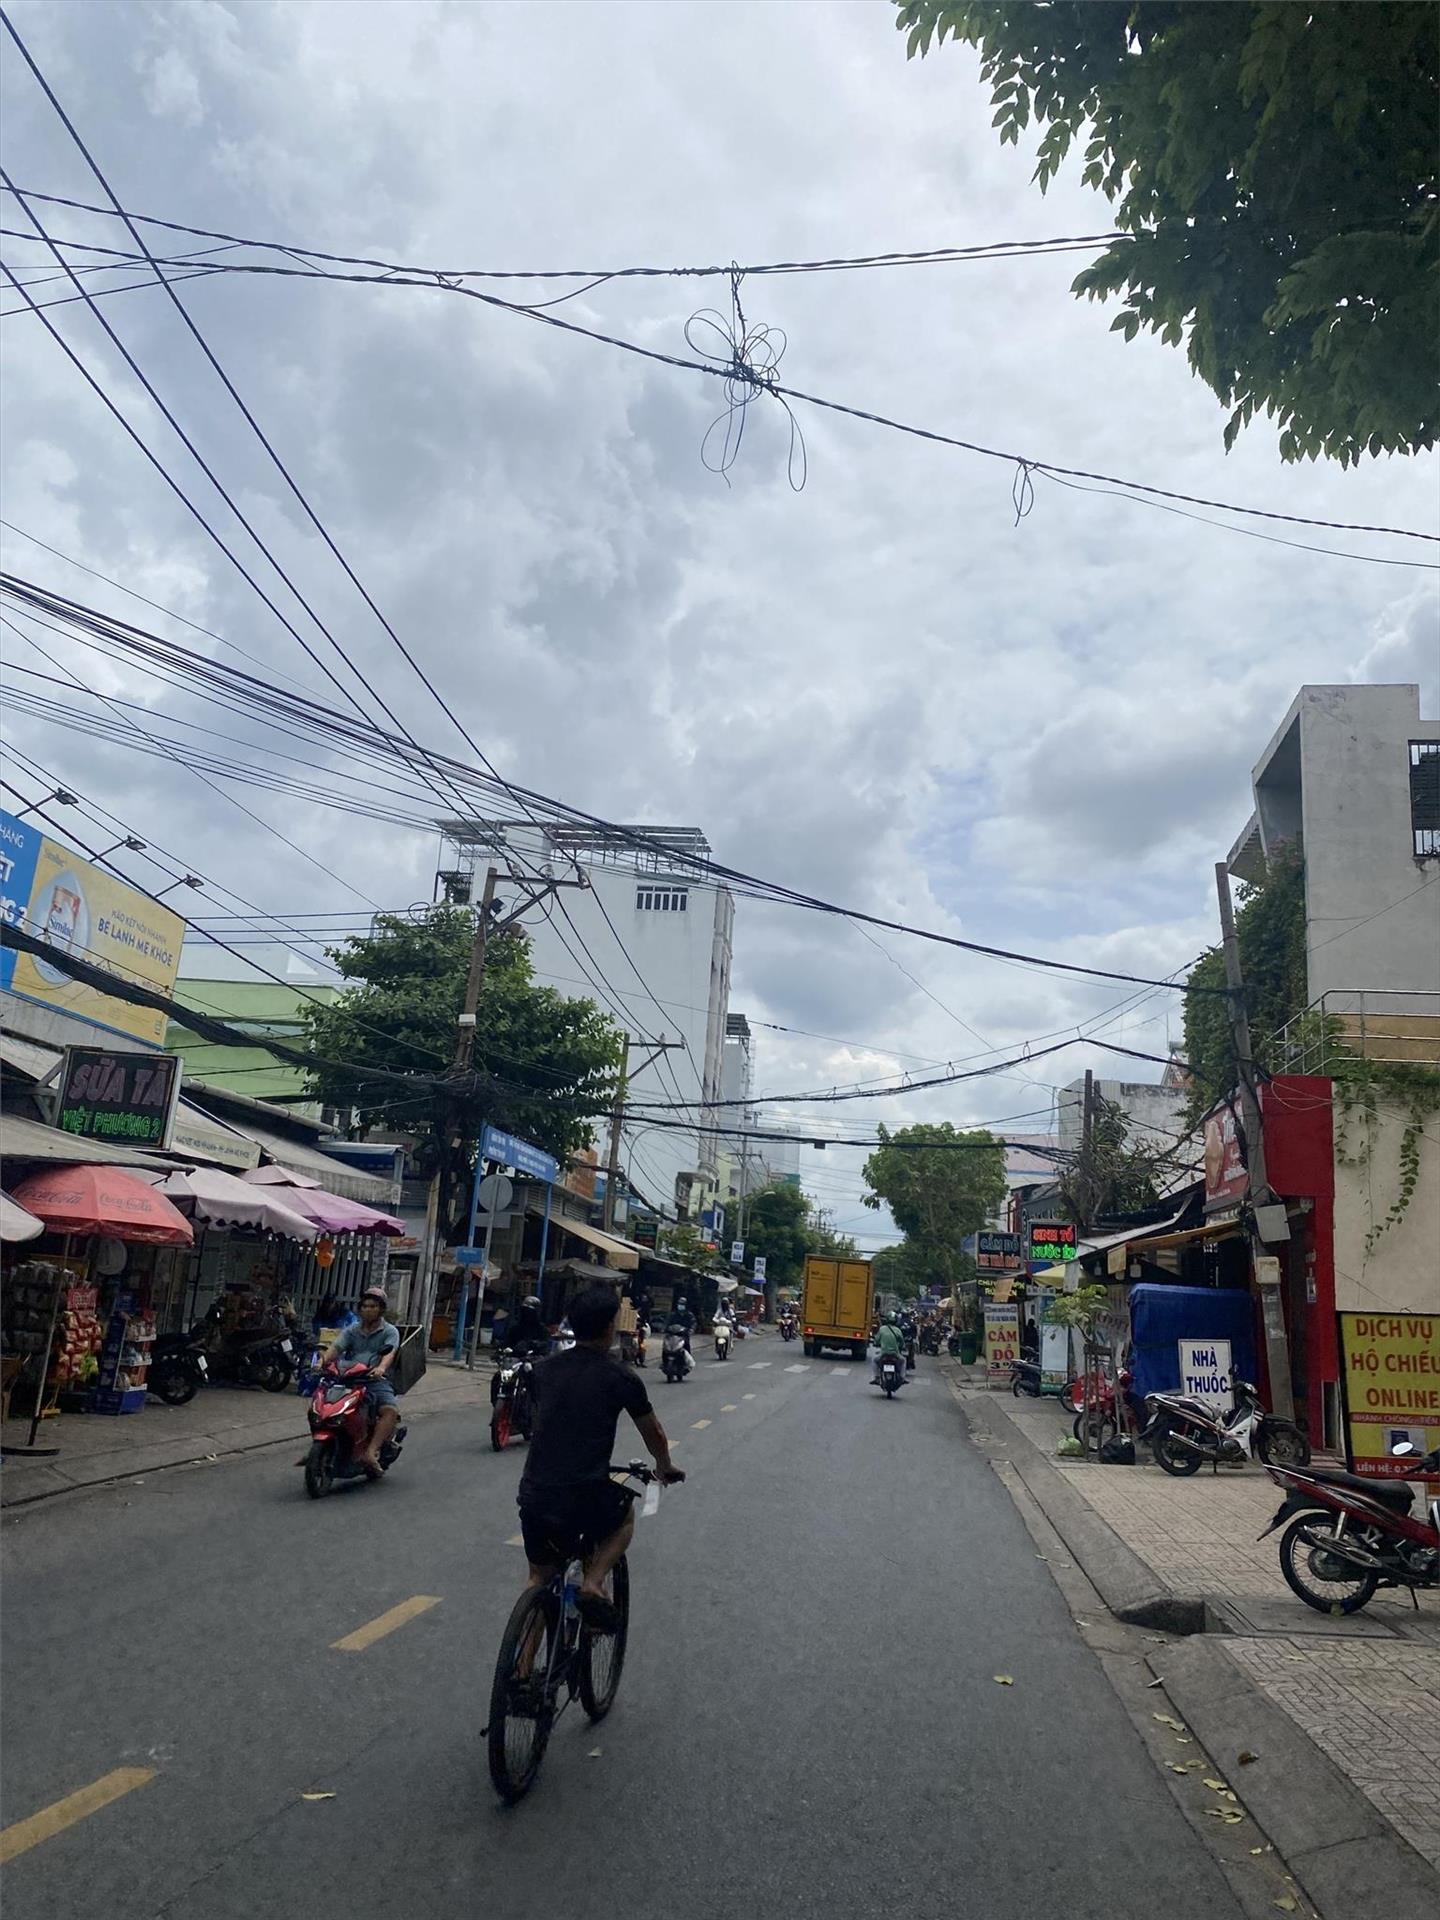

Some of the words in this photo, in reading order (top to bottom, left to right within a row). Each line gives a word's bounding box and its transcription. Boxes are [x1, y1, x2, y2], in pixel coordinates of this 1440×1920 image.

[68, 1057, 126, 1102] SỮA
[150, 1117, 161, 1138] 2
[1356, 1319, 1402, 1342] DỊCH
[1406, 1319, 1433, 1344] VỤ
[1192, 1346, 1218, 1368] NHÀ
[1352, 1348, 1379, 1376] HỘ
[1385, 1348, 1440, 1374] CHIẾU
[1186, 1369, 1228, 1394] THUỐC
[1366, 1387, 1440, 1409] ONLINE
